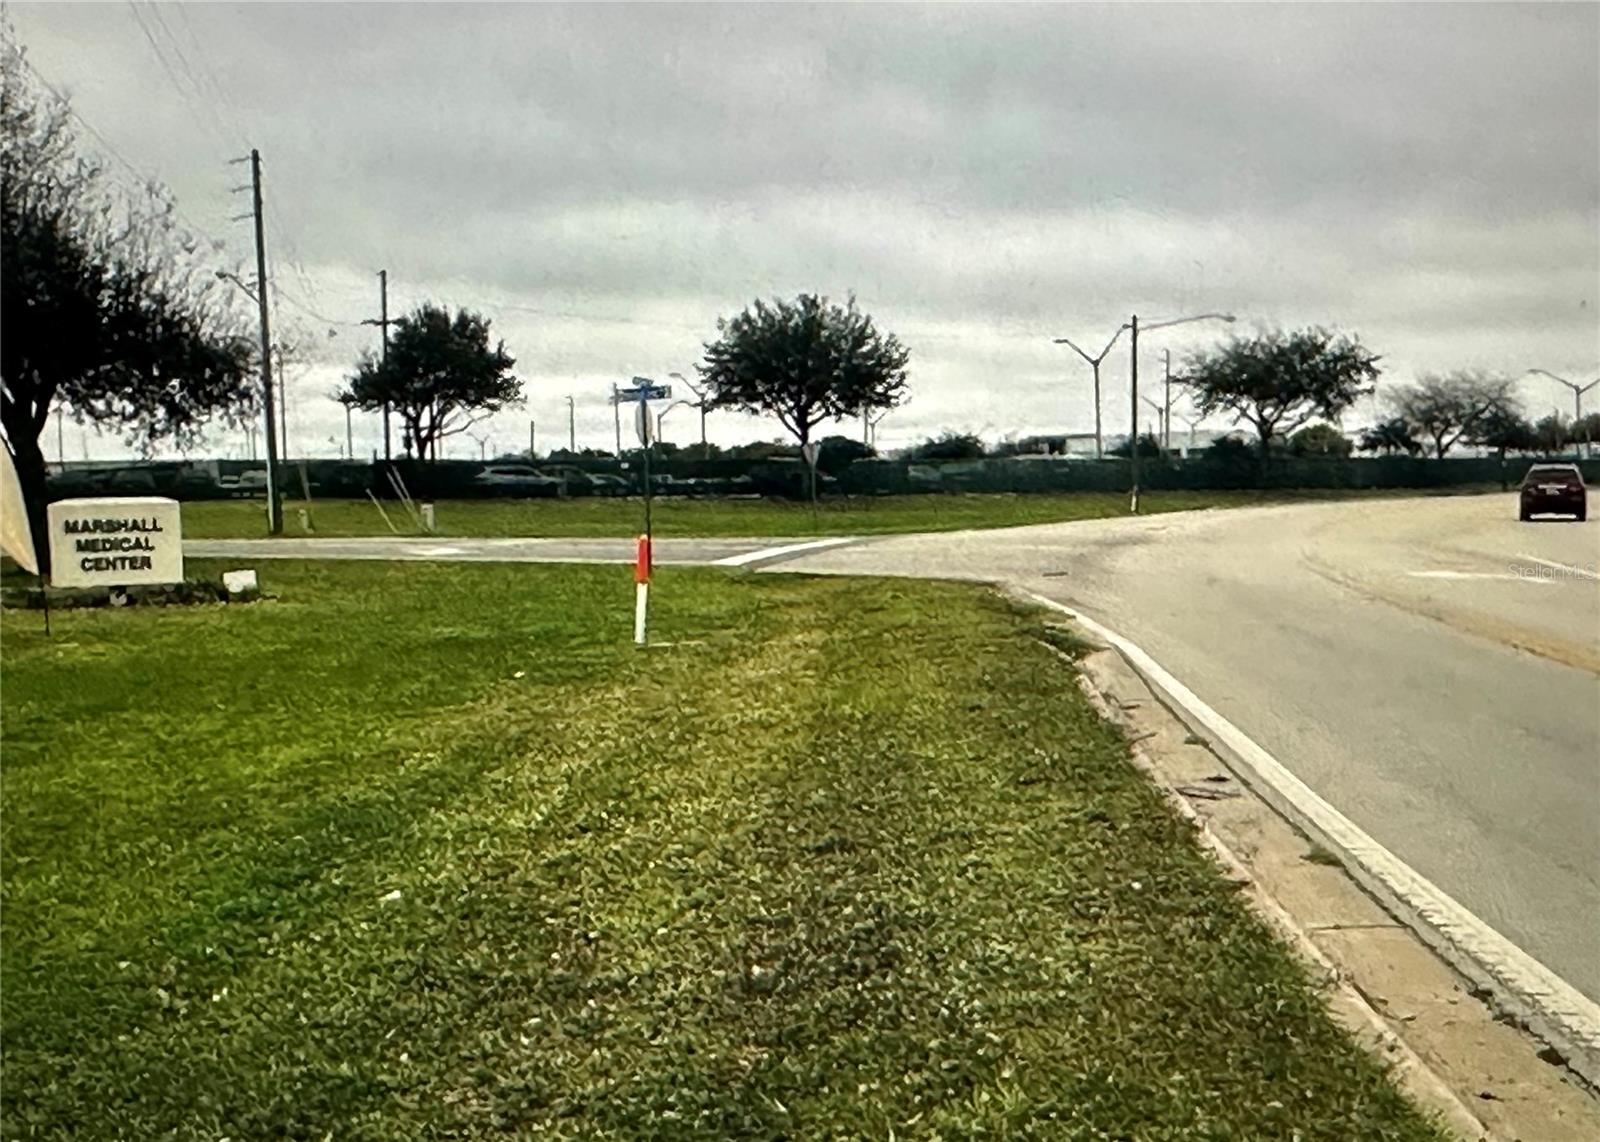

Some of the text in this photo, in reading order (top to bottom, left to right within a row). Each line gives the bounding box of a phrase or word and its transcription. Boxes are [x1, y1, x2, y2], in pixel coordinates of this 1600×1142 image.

[64, 517, 163, 533] MARSHALL
[76, 536, 155, 552] MEDICAL
[81, 556, 152, 572] CENTER
